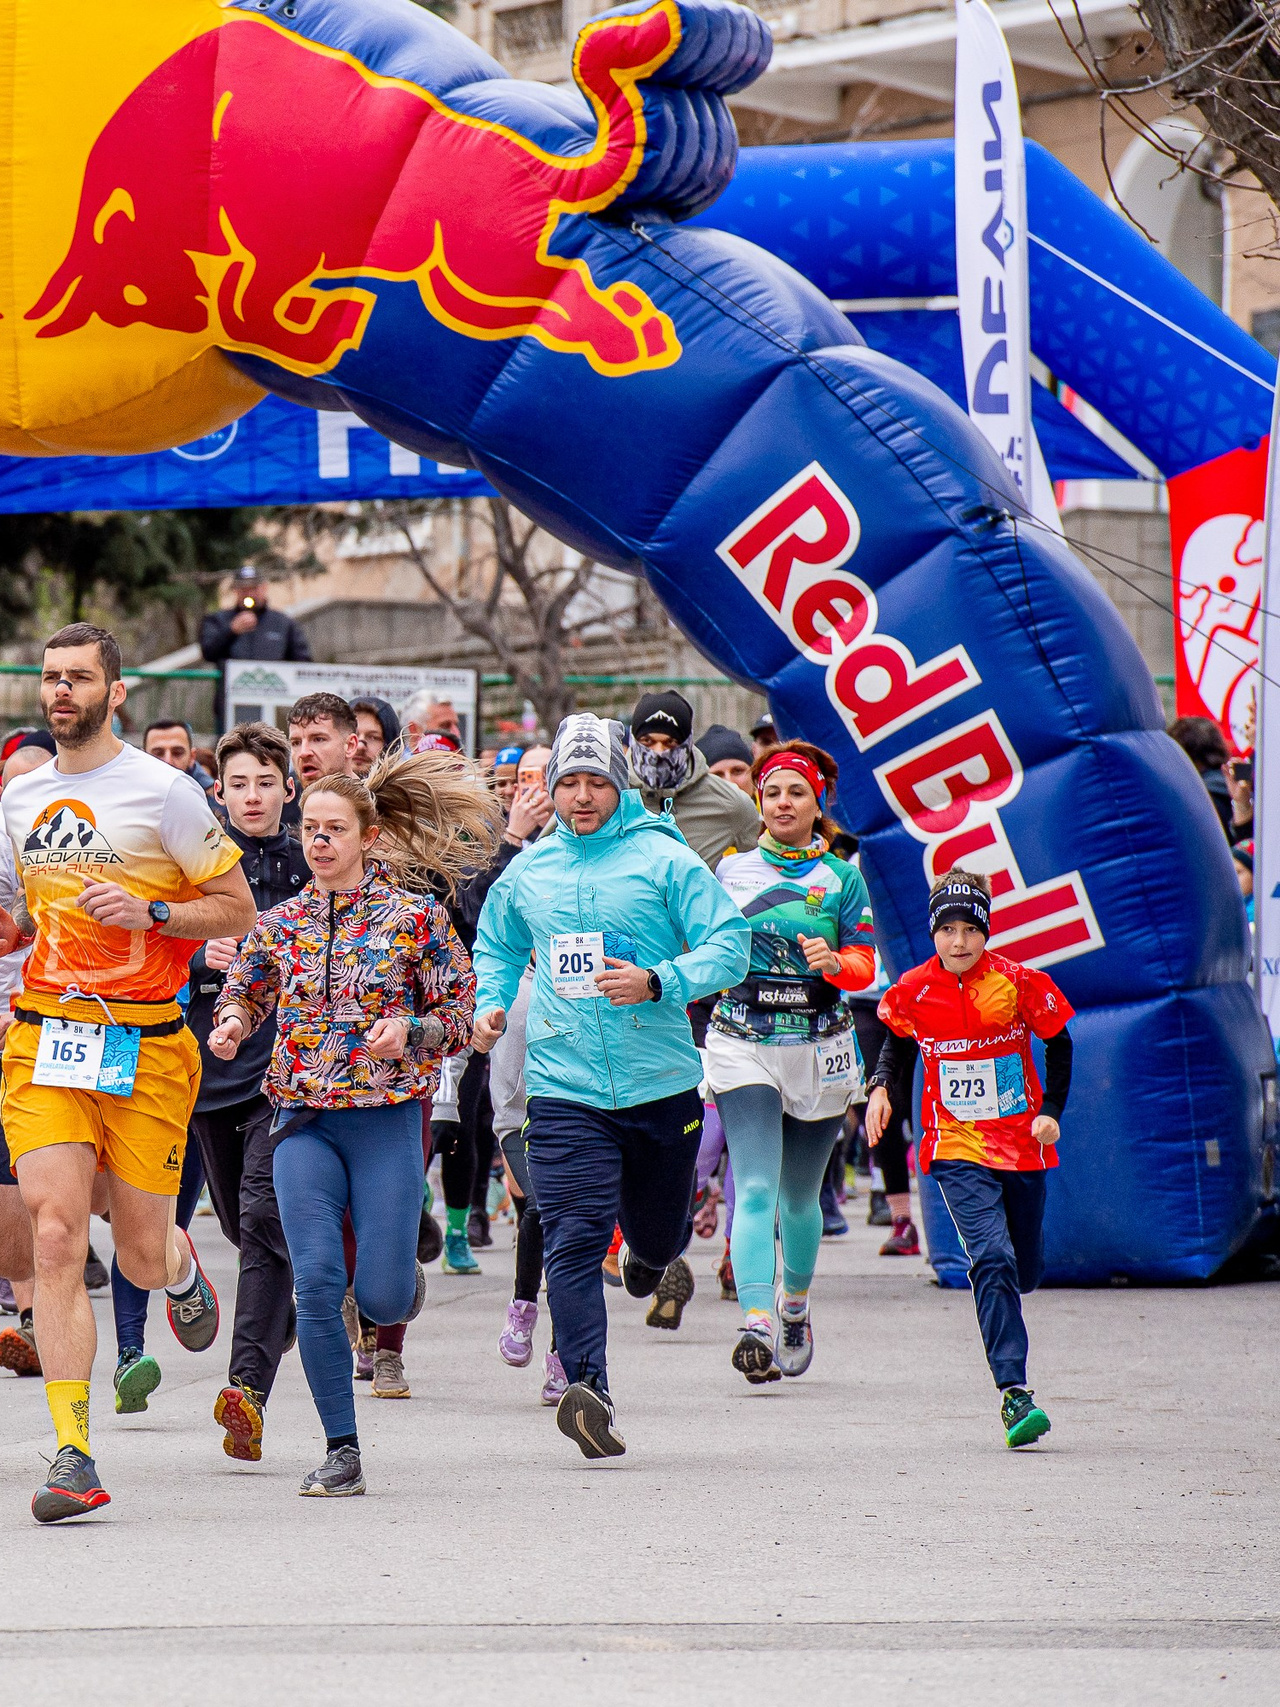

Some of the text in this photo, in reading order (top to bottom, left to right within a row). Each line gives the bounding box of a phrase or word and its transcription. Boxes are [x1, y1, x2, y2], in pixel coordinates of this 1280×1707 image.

[728, 474, 1091, 966] Red Bull
[30, 863, 104, 877] SKY RUN
[947, 883, 971, 895] 100
[973, 902, 988, 924] 100
[575, 936, 584, 944] 8K
[558, 952, 594, 975] 205
[74, 1025, 84, 1034] 8K
[52, 1039, 88, 1063] 165
[825, 1051, 851, 1075] 223
[965, 1063, 975, 1072] 8K
[949, 1078, 986, 1098] 273
[683, 1119, 700, 1135] JAKO
